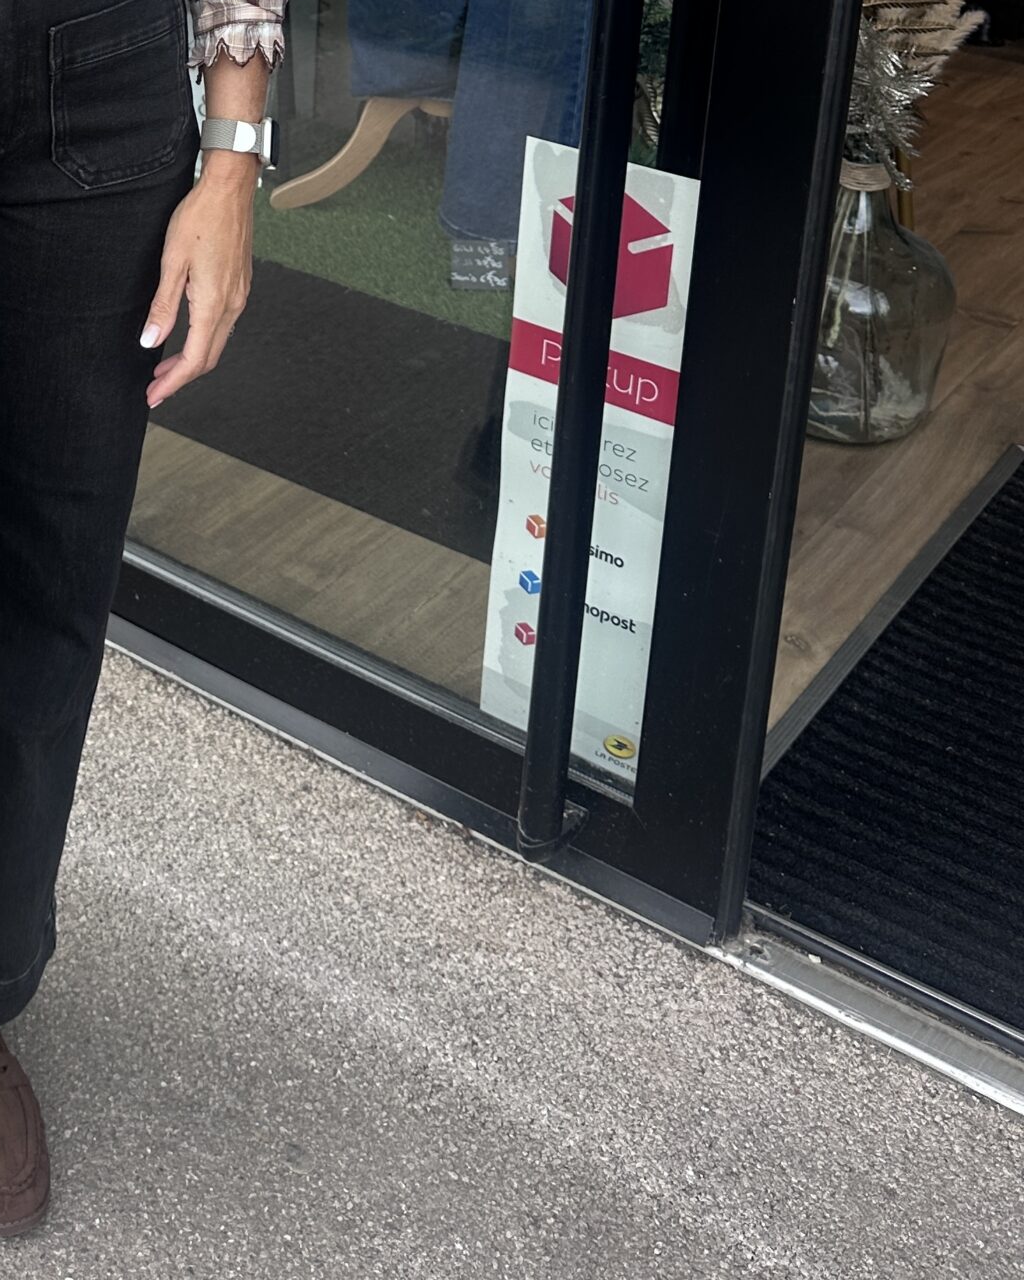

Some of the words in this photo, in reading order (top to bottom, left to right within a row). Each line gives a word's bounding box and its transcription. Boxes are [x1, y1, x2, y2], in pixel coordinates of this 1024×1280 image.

[532, 409, 554, 431] ici
[530, 436, 554, 456] et
[594, 749, 607, 760] LA
[607, 755, 637, 774] POSTE
